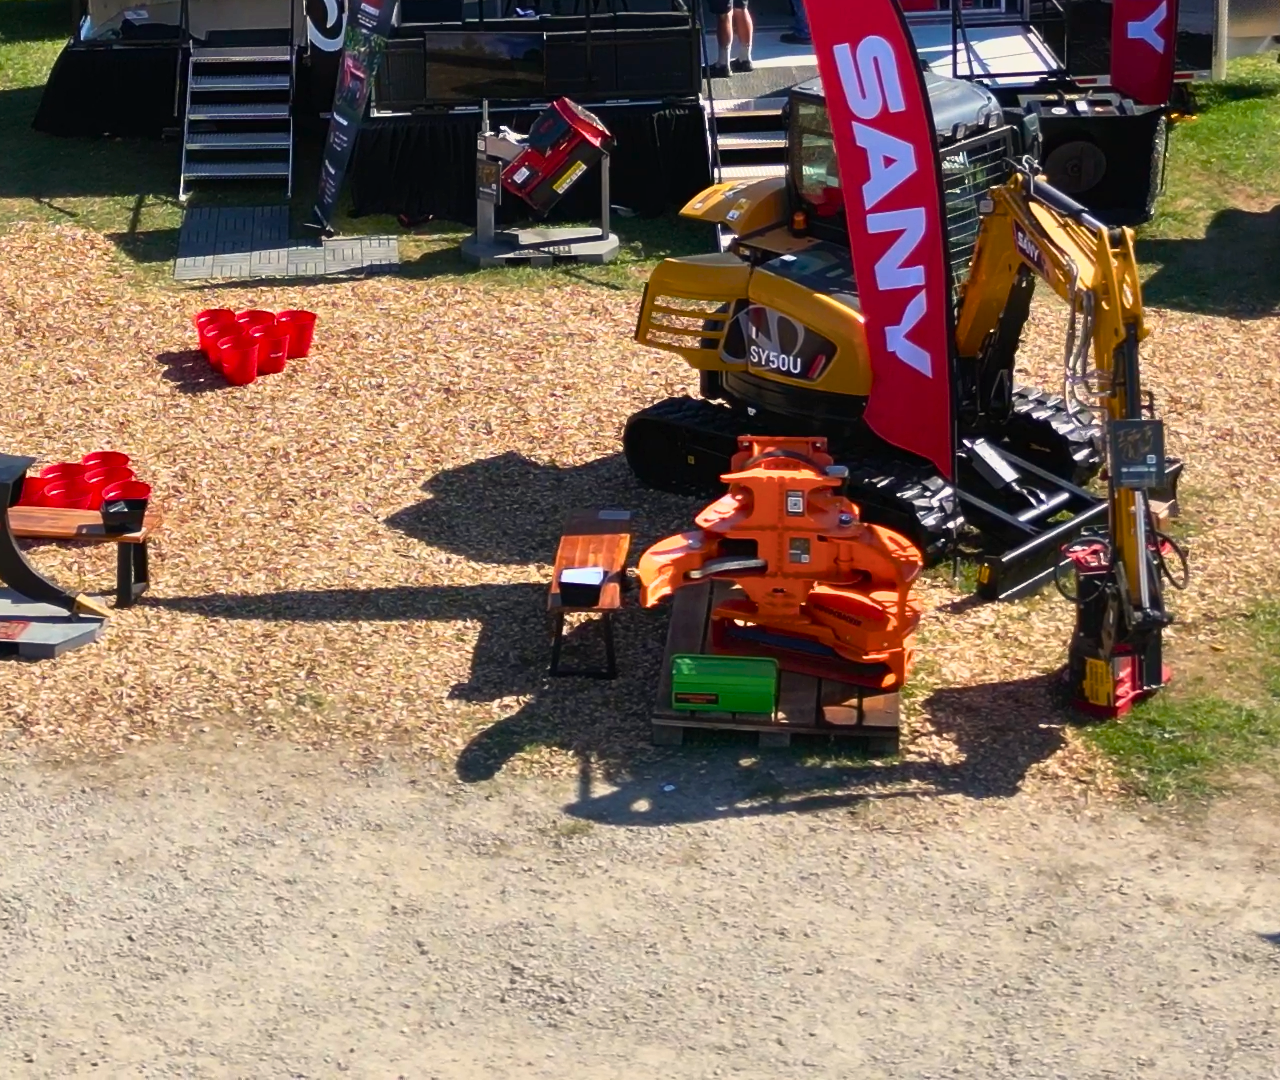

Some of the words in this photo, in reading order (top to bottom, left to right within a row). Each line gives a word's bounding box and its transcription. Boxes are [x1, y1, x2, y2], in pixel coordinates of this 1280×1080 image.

[833, 34, 934, 379] SANY
[1017, 231, 1041, 262] SANY
[750, 344, 801, 374] SY50U
